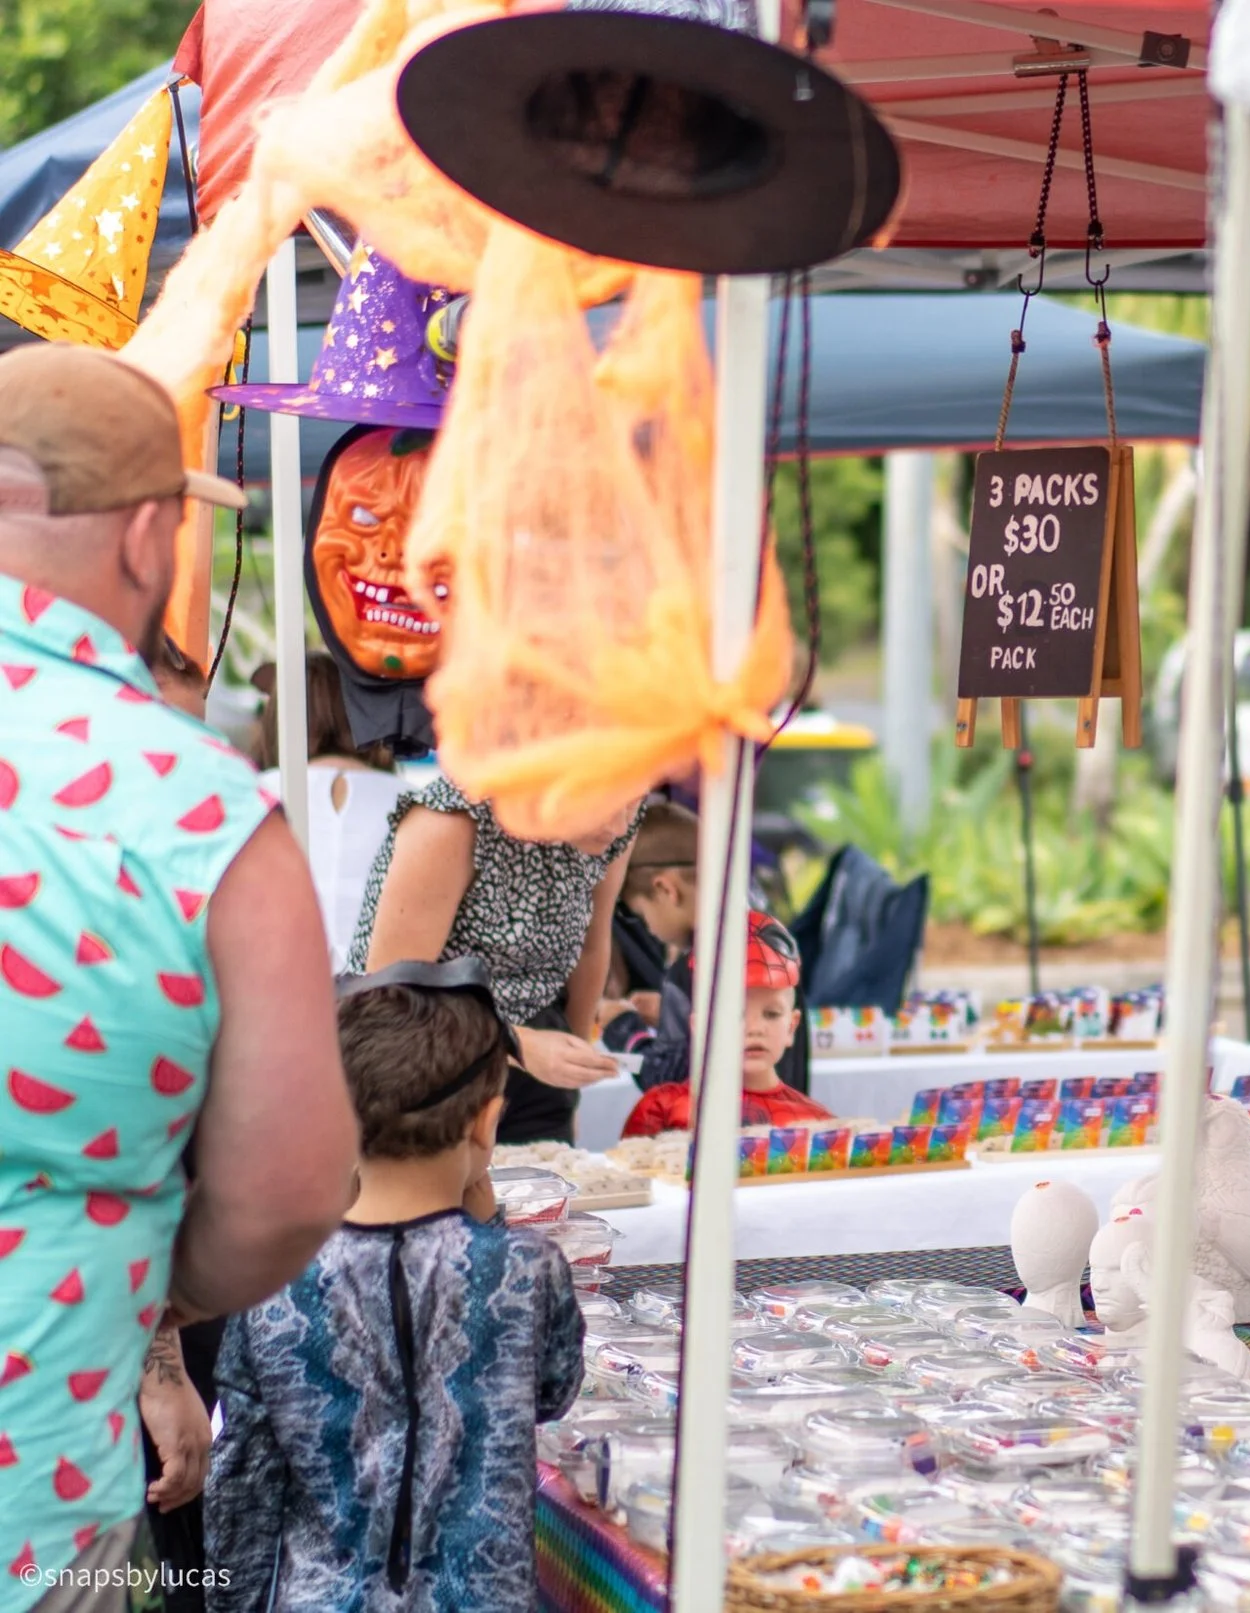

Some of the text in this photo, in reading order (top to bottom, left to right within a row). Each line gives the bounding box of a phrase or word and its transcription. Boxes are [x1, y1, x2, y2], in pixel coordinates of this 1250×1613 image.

[989, 473, 1099, 508] 3 PACKS
[1003, 514, 1060, 557] $30
[971, 564, 1005, 599] OR
[1050, 606, 1094, 631] EACH
[990, 645, 1037, 670] PACK
